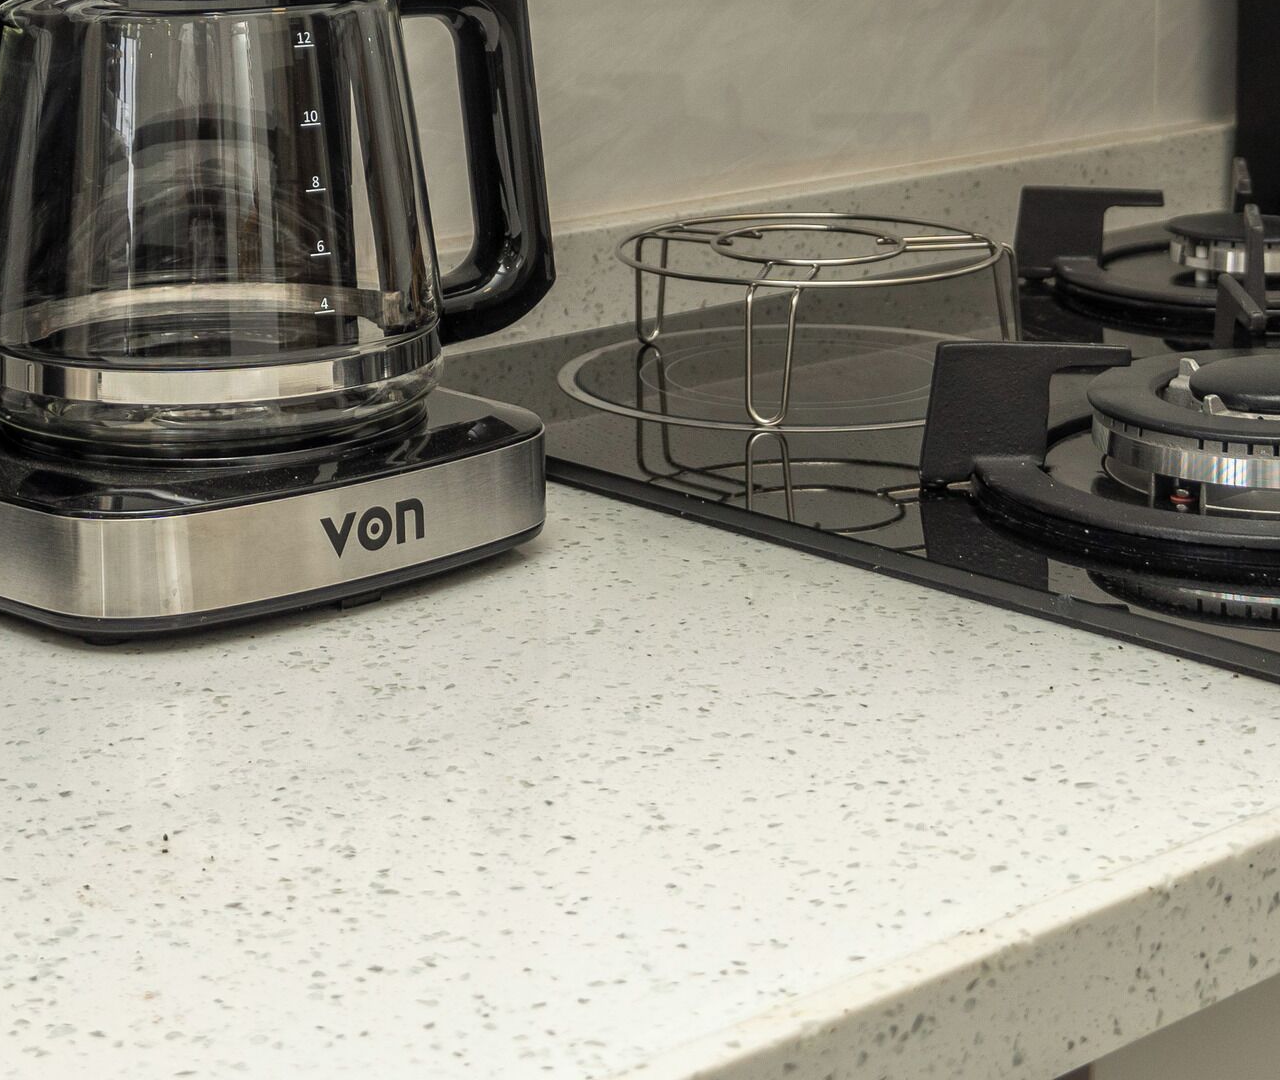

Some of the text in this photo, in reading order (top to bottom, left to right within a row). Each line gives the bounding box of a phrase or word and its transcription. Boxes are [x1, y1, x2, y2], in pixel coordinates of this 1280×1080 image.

[296, 31, 312, 44] 12
[303, 110, 318, 123] 10
[311, 176, 320, 188] 8
[316, 240, 325, 253] 6
[320, 297, 330, 310] 4
